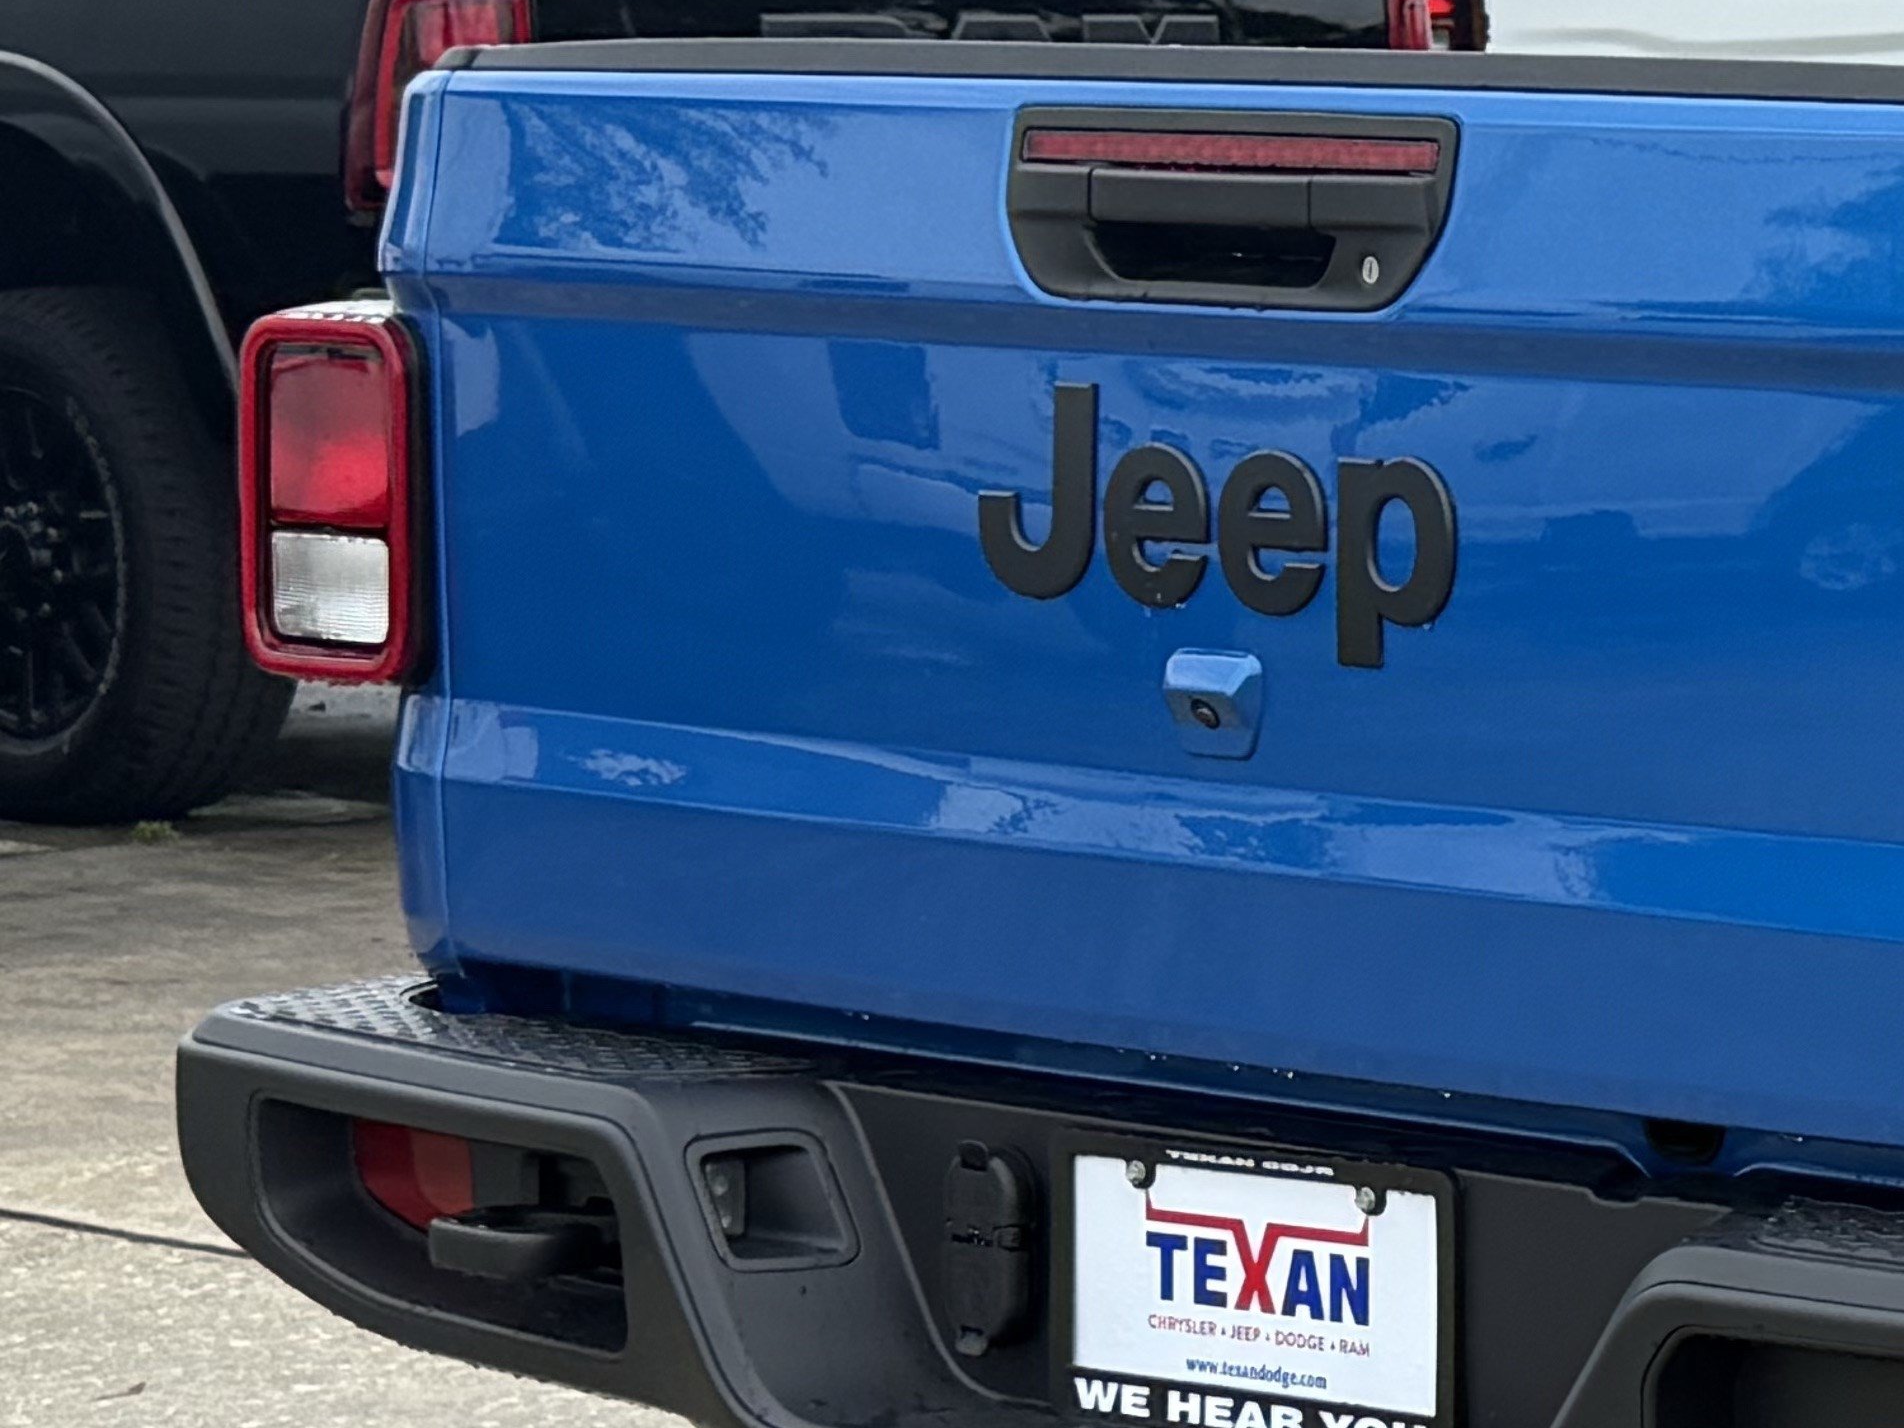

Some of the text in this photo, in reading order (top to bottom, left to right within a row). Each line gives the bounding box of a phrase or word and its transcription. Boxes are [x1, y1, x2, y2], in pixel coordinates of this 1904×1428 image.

[978, 382, 1457, 669] Jeep
[1146, 1217, 1370, 1326] TEXAN
[1148, 1314, 1370, 1357] CHRYSLER JEEP DODGE RAM
[1186, 1357, 1327, 1389] www.texandodge.com
[1074, 1377, 1150, 1418] WE
